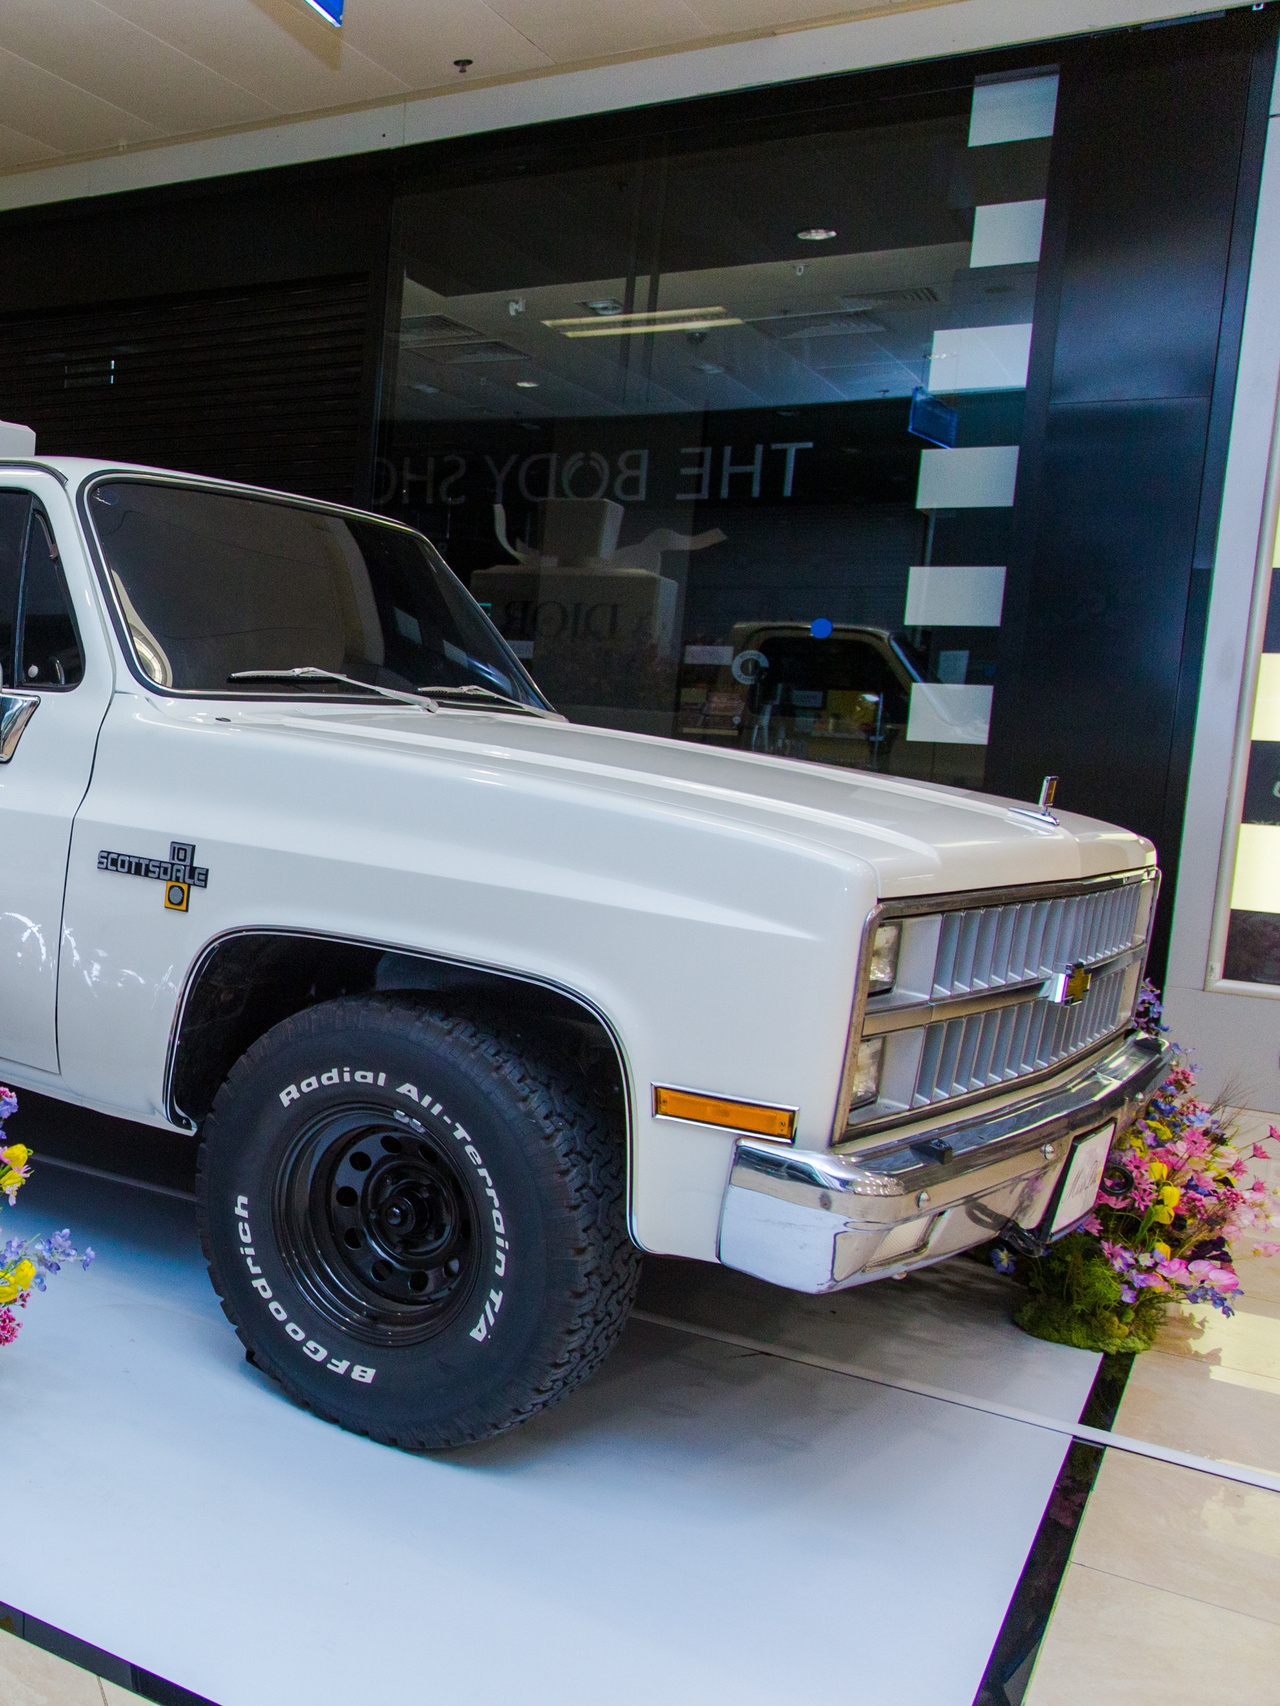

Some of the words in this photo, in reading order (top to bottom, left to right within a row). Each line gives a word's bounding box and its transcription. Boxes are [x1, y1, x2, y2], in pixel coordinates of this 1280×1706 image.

[97, 849, 208, 888] SCOTTSDALE
[234, 1194, 377, 1384] BFGoodrich
[278, 1066, 387, 1108] Radial
[396, 1081, 510, 1277] All-Terrain
[469, 1288, 503, 1342] T/A
